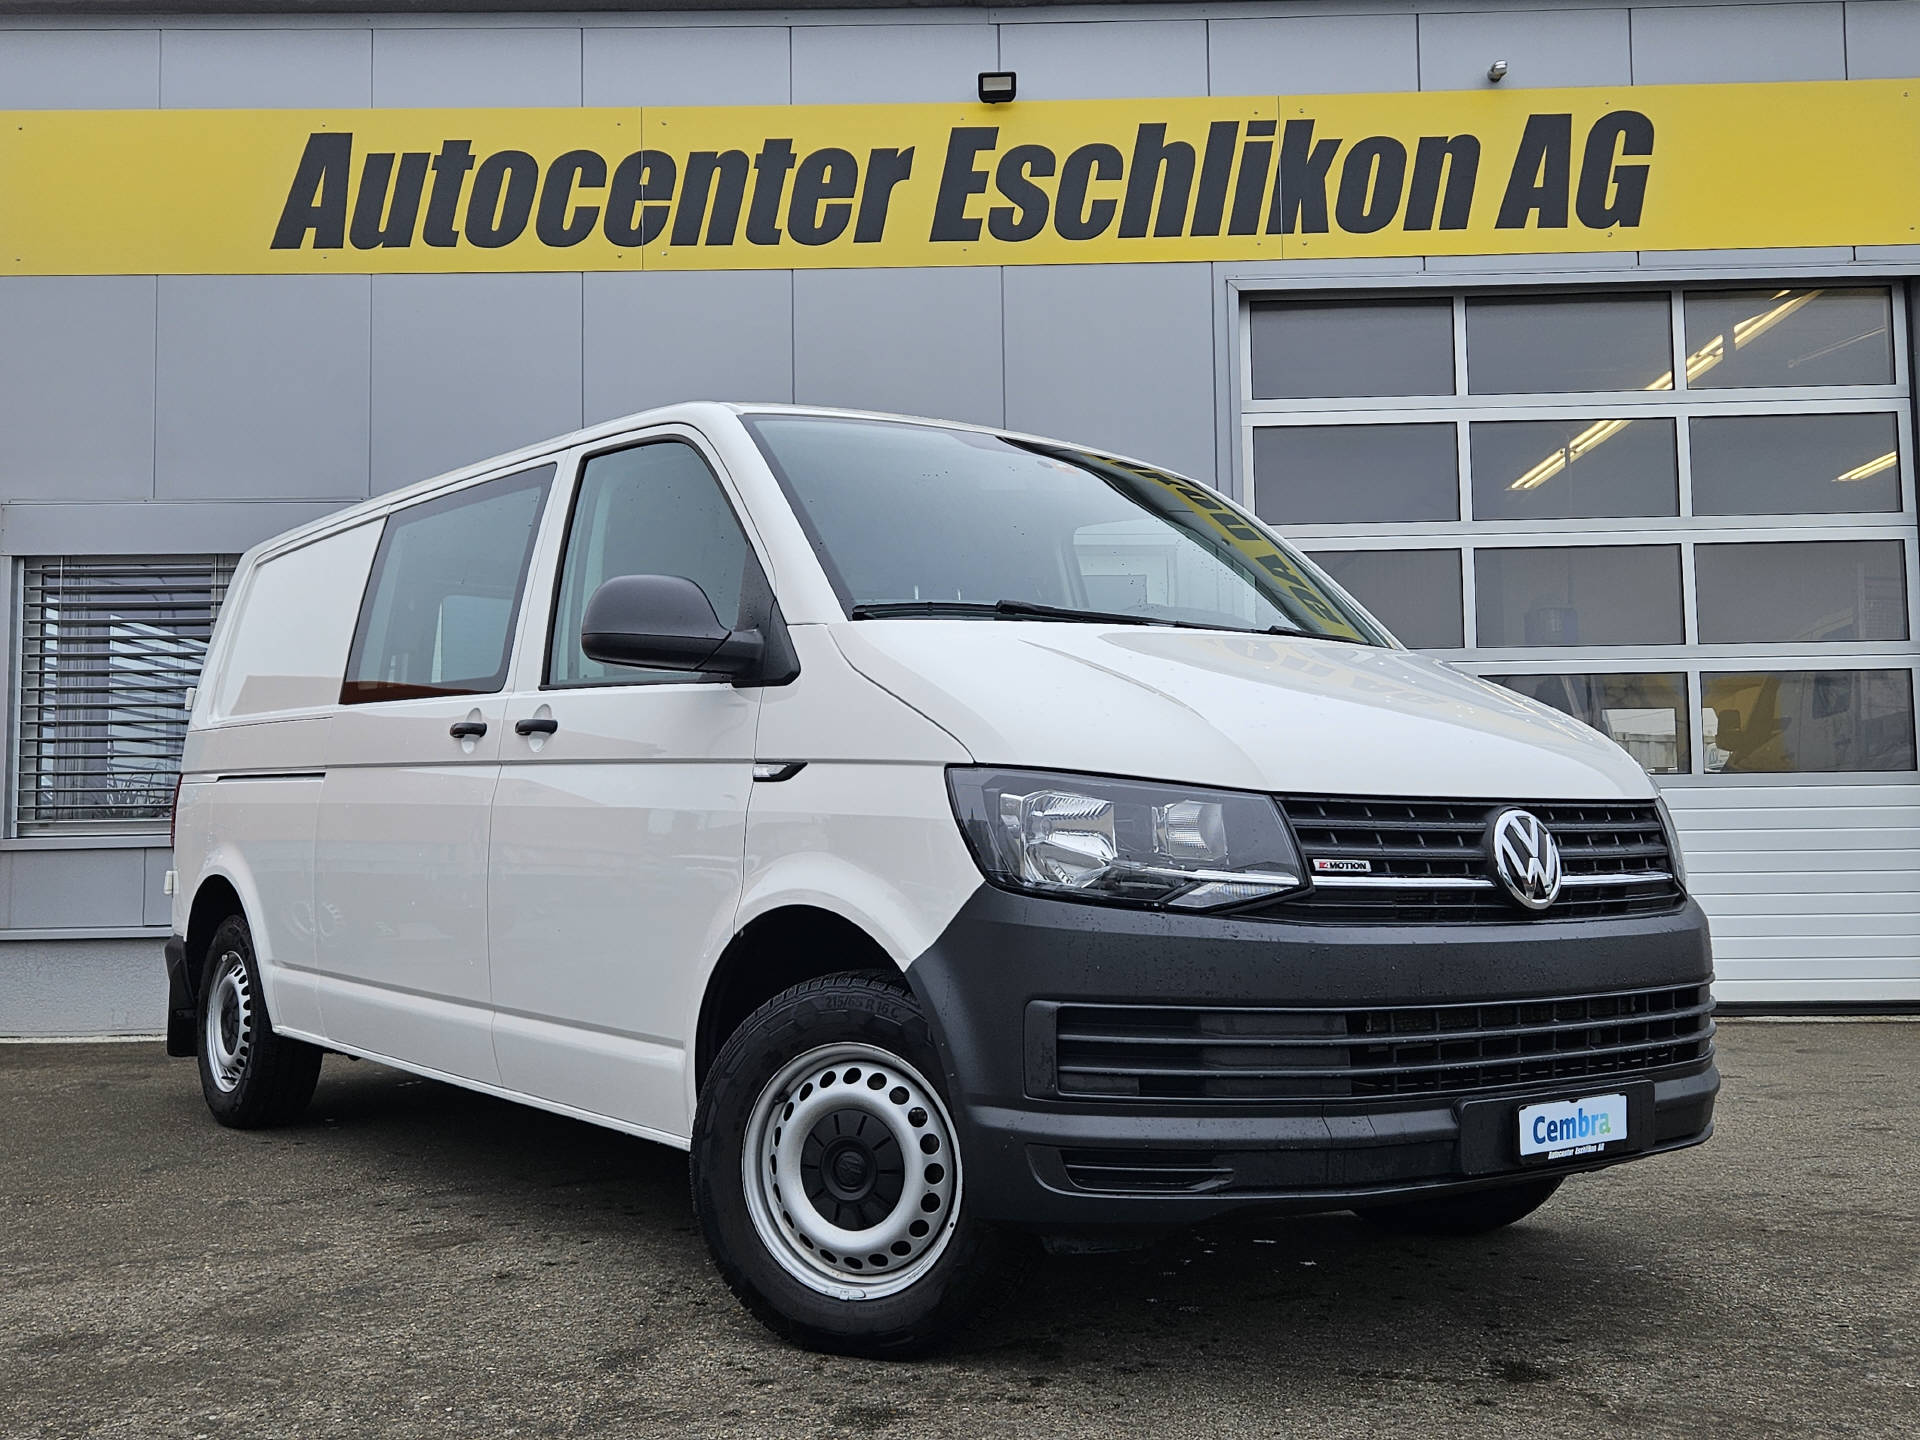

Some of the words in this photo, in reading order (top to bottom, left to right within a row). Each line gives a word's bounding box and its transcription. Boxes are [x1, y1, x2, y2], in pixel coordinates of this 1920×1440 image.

[269, 132, 915, 250] Autocenter
[929, 118, 1481, 242] Eschlikon
[1494, 110, 1655, 231] AG
[1532, 1107, 1612, 1145] Cembra
